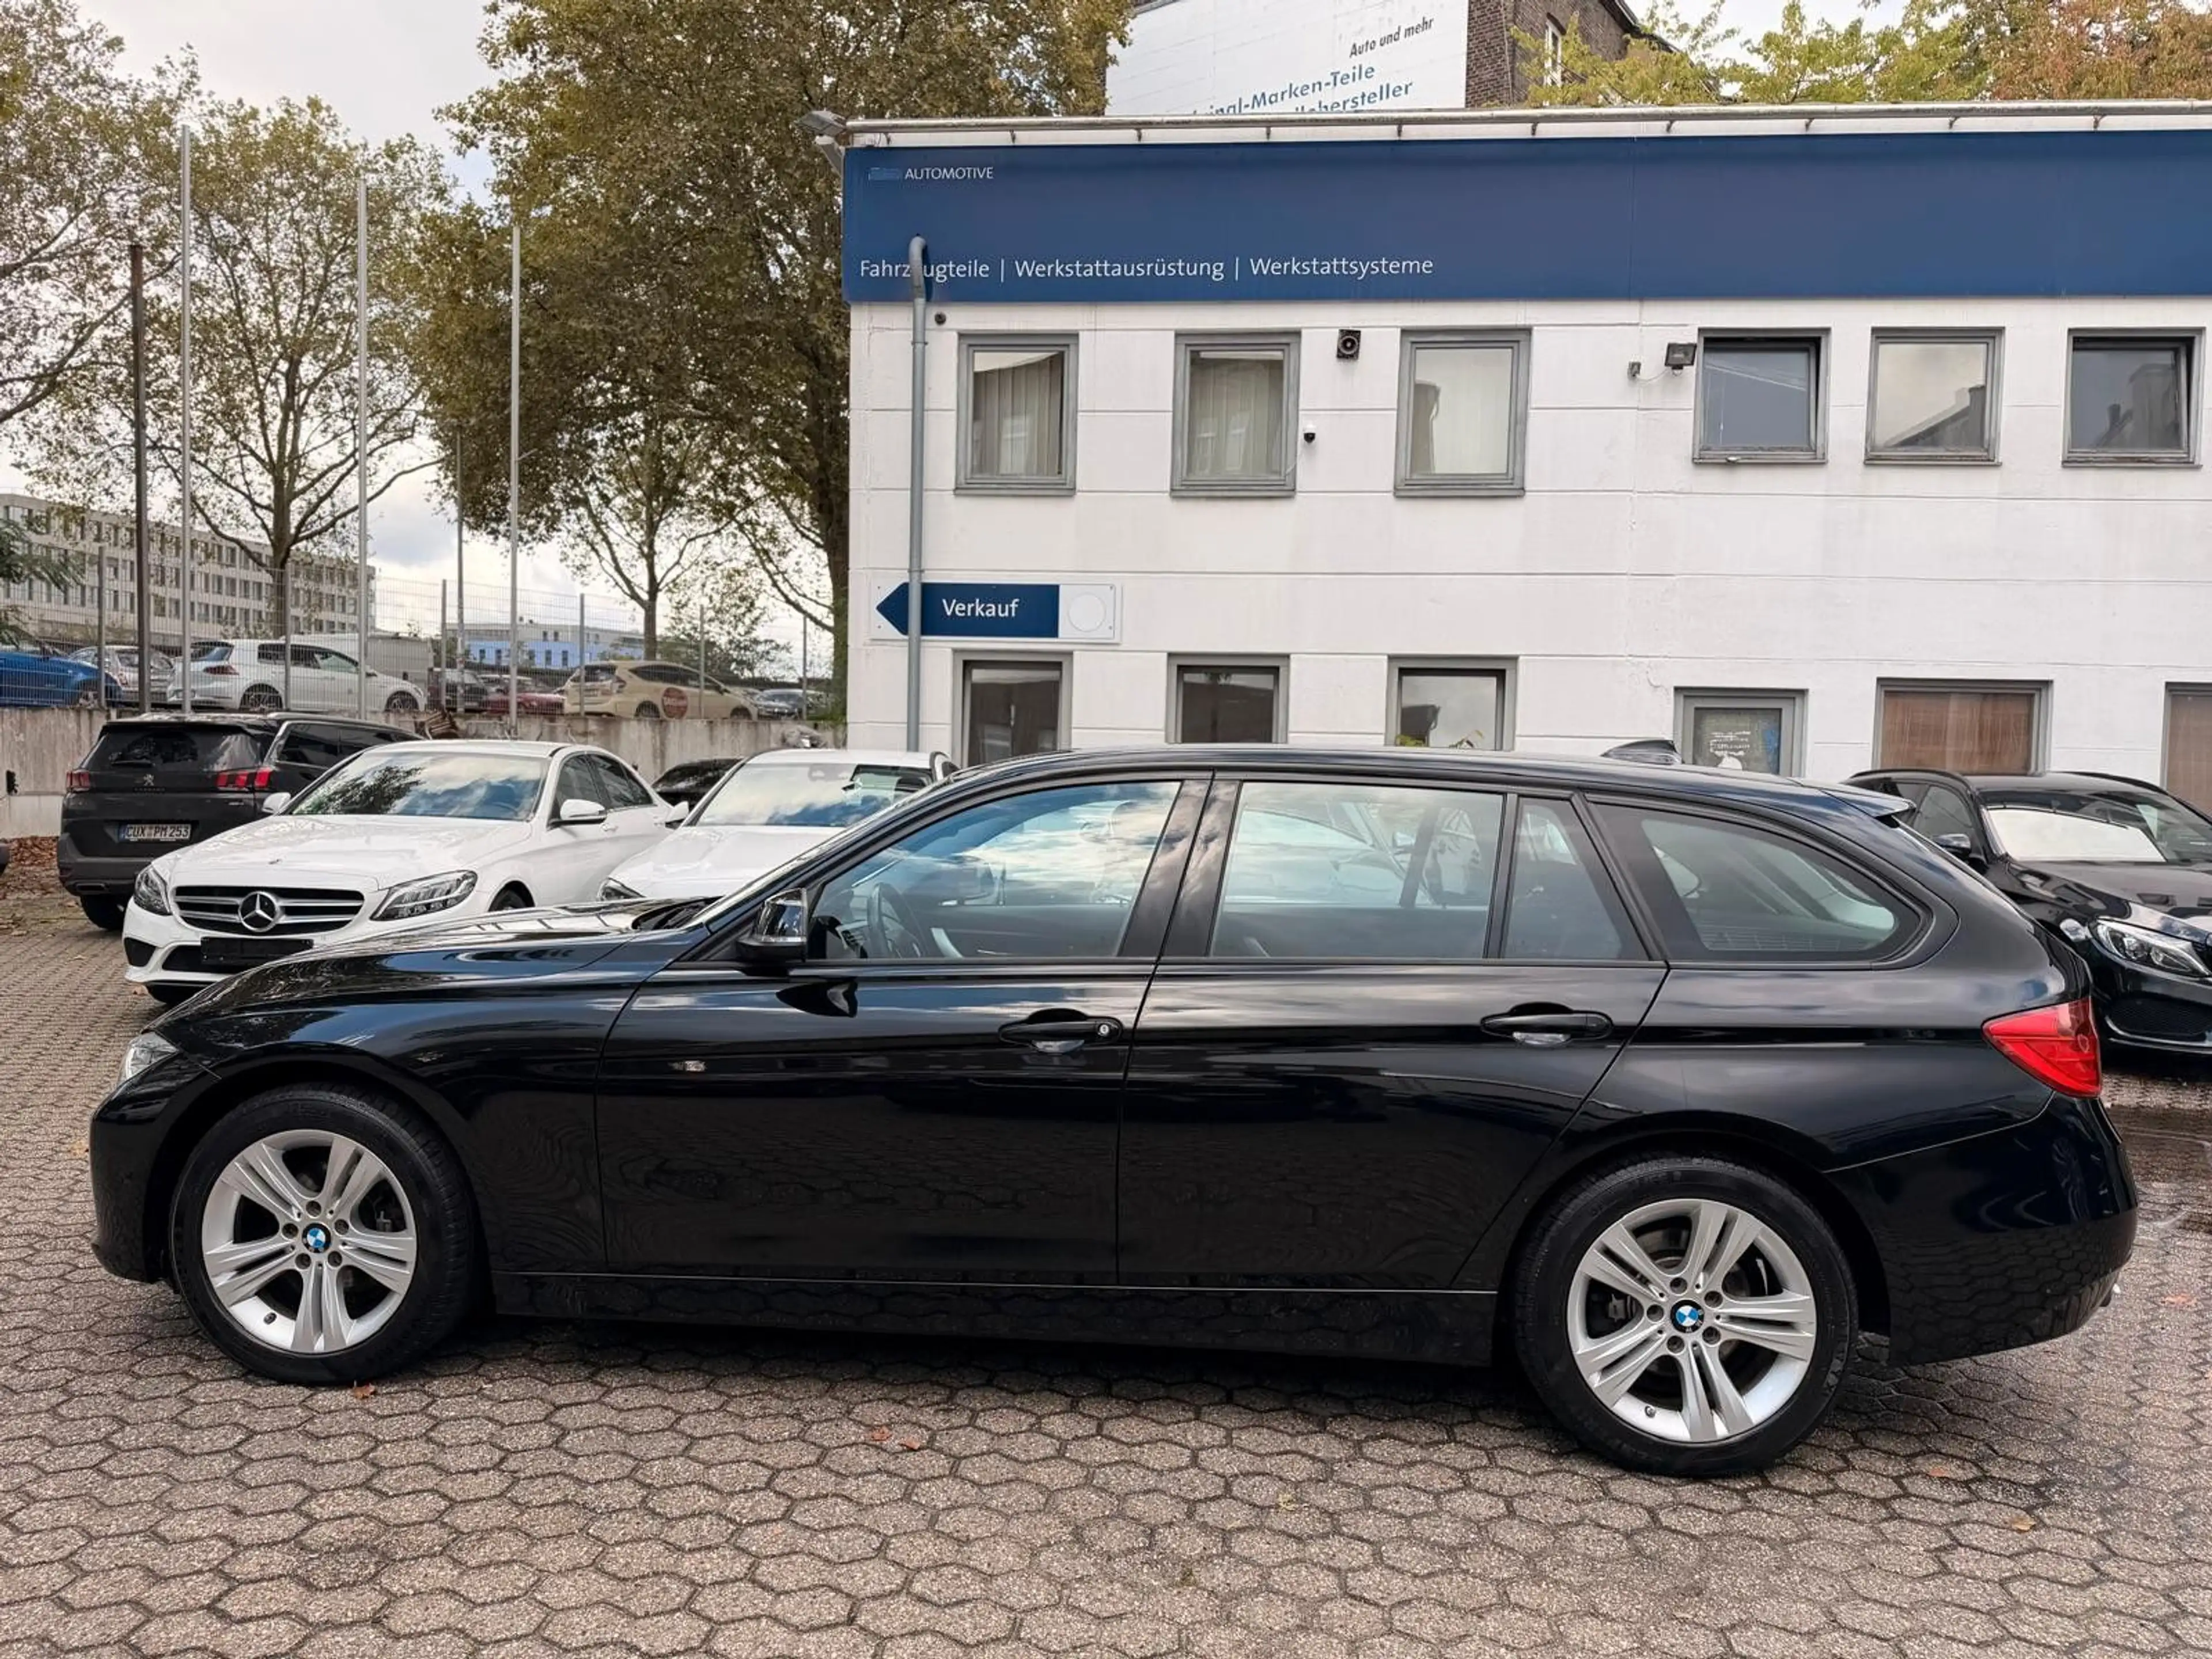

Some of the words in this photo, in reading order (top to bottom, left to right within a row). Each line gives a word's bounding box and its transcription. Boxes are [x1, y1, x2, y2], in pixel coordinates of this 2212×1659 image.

[1349, 40, 1376, 58] Auto
[1380, 25, 1401, 47] und
[1404, 16, 1434, 39] mehr
[904, 166, 994, 180] AUTOMOTIVE
[860, 259, 990, 283] Fahrzugteile
[1014, 257, 1225, 281] Werkstattausrüstung
[1250, 257, 1433, 280] Werkstattsysteme
[942, 599, 1019, 617] Verkauf
